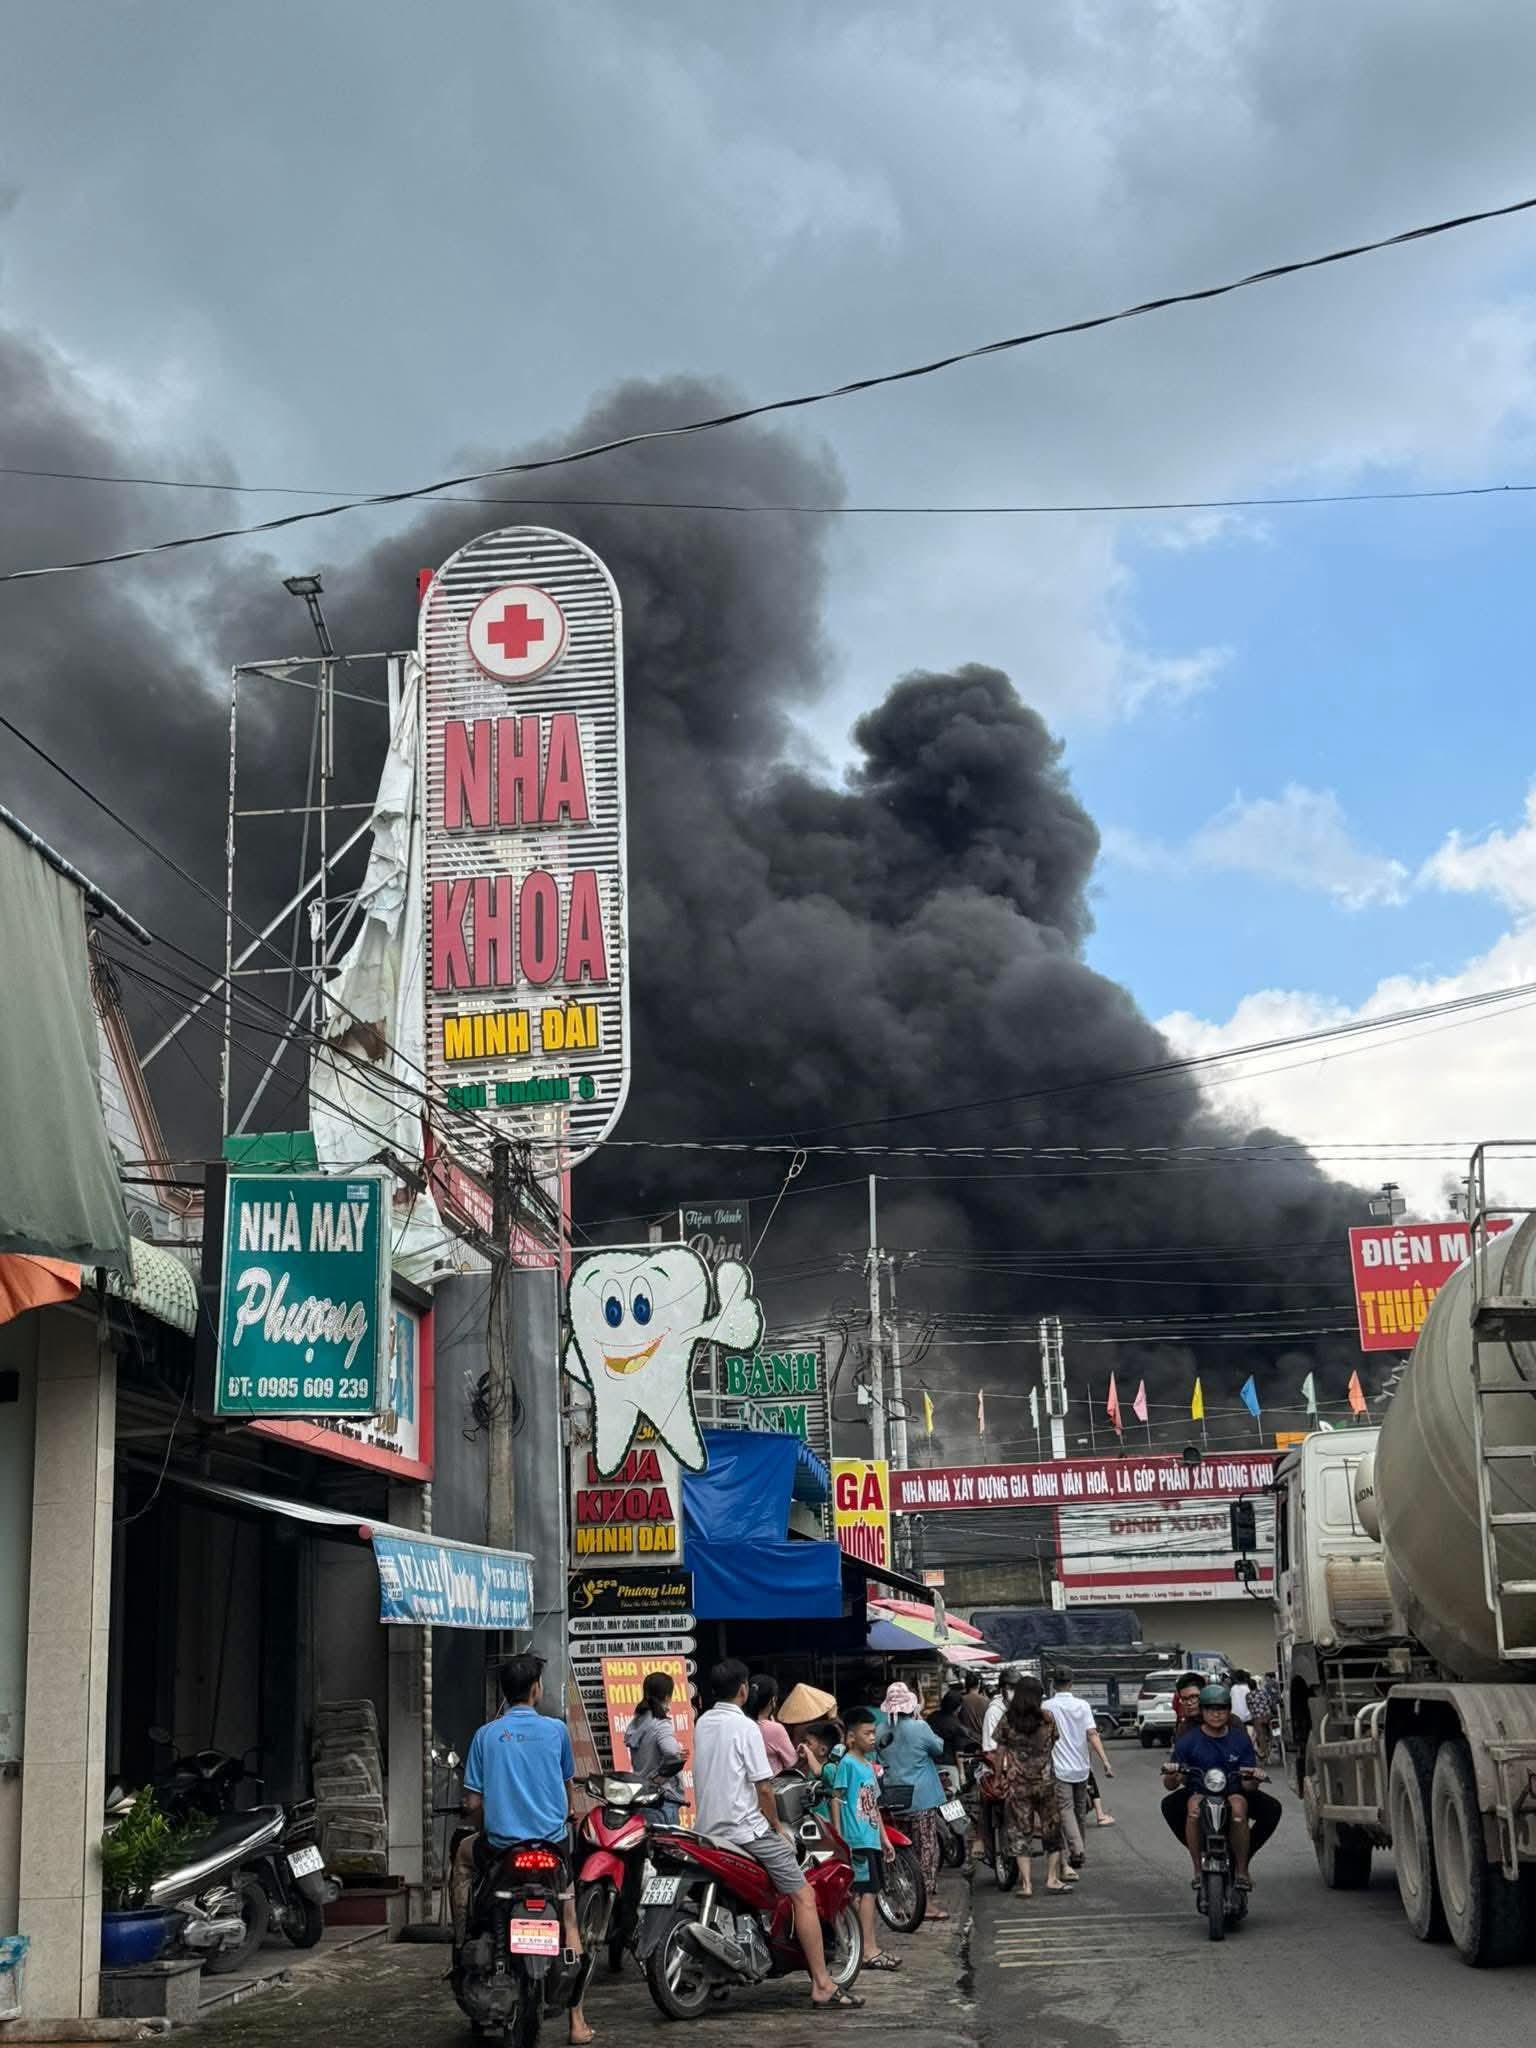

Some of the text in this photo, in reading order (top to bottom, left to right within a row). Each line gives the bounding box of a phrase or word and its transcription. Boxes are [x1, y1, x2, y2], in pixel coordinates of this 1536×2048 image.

[444, 713, 589, 829] NHA
[431, 869, 608, 990] KHOA
[443, 998, 600, 1061] MINH ĐÀI
[448, 1074, 596, 1112] CHI NHÁNH 6
[239, 1190, 369, 1252] NHÀ MAY
[714, 1207, 743, 1225] Bánh
[1361, 1230, 1433, 1271] ĐIỆN
[232, 1266, 368, 1370] Phượng
[228, 1376, 369, 1400] ĐT: 0985 609 239
[836, 1464, 884, 1511] GÀ
[902, 1475, 925, 1503] NHÀ
[927, 1474, 950, 1502] NHÀ
[953, 1473, 974, 1500] XÂY
[978, 1474, 1008, 1503] DỰNG
[1010, 1474, 1029, 1498] GIA
[1032, 1469, 1059, 1497] ĐÌNH
[1061, 1468, 1084, 1496] VĂN
[1116, 1465, 1132, 1493] LÀ
[1133, 1463, 1155, 1492] GÓP
[1158, 1458, 1190, 1491] PHẦN
[1193, 1461, 1214, 1490] XÂY
[1217, 1463, 1249, 1492] DỰNG
[1250, 1463, 1274, 1487] KHU
[577, 1488, 675, 1524] KHOA
[576, 1522, 677, 1554] MINH ĐÀI
[660, 1583, 686, 1597] Linh
[606, 1661, 638, 1676] NHA
[641, 1660, 683, 1676] KHOA
